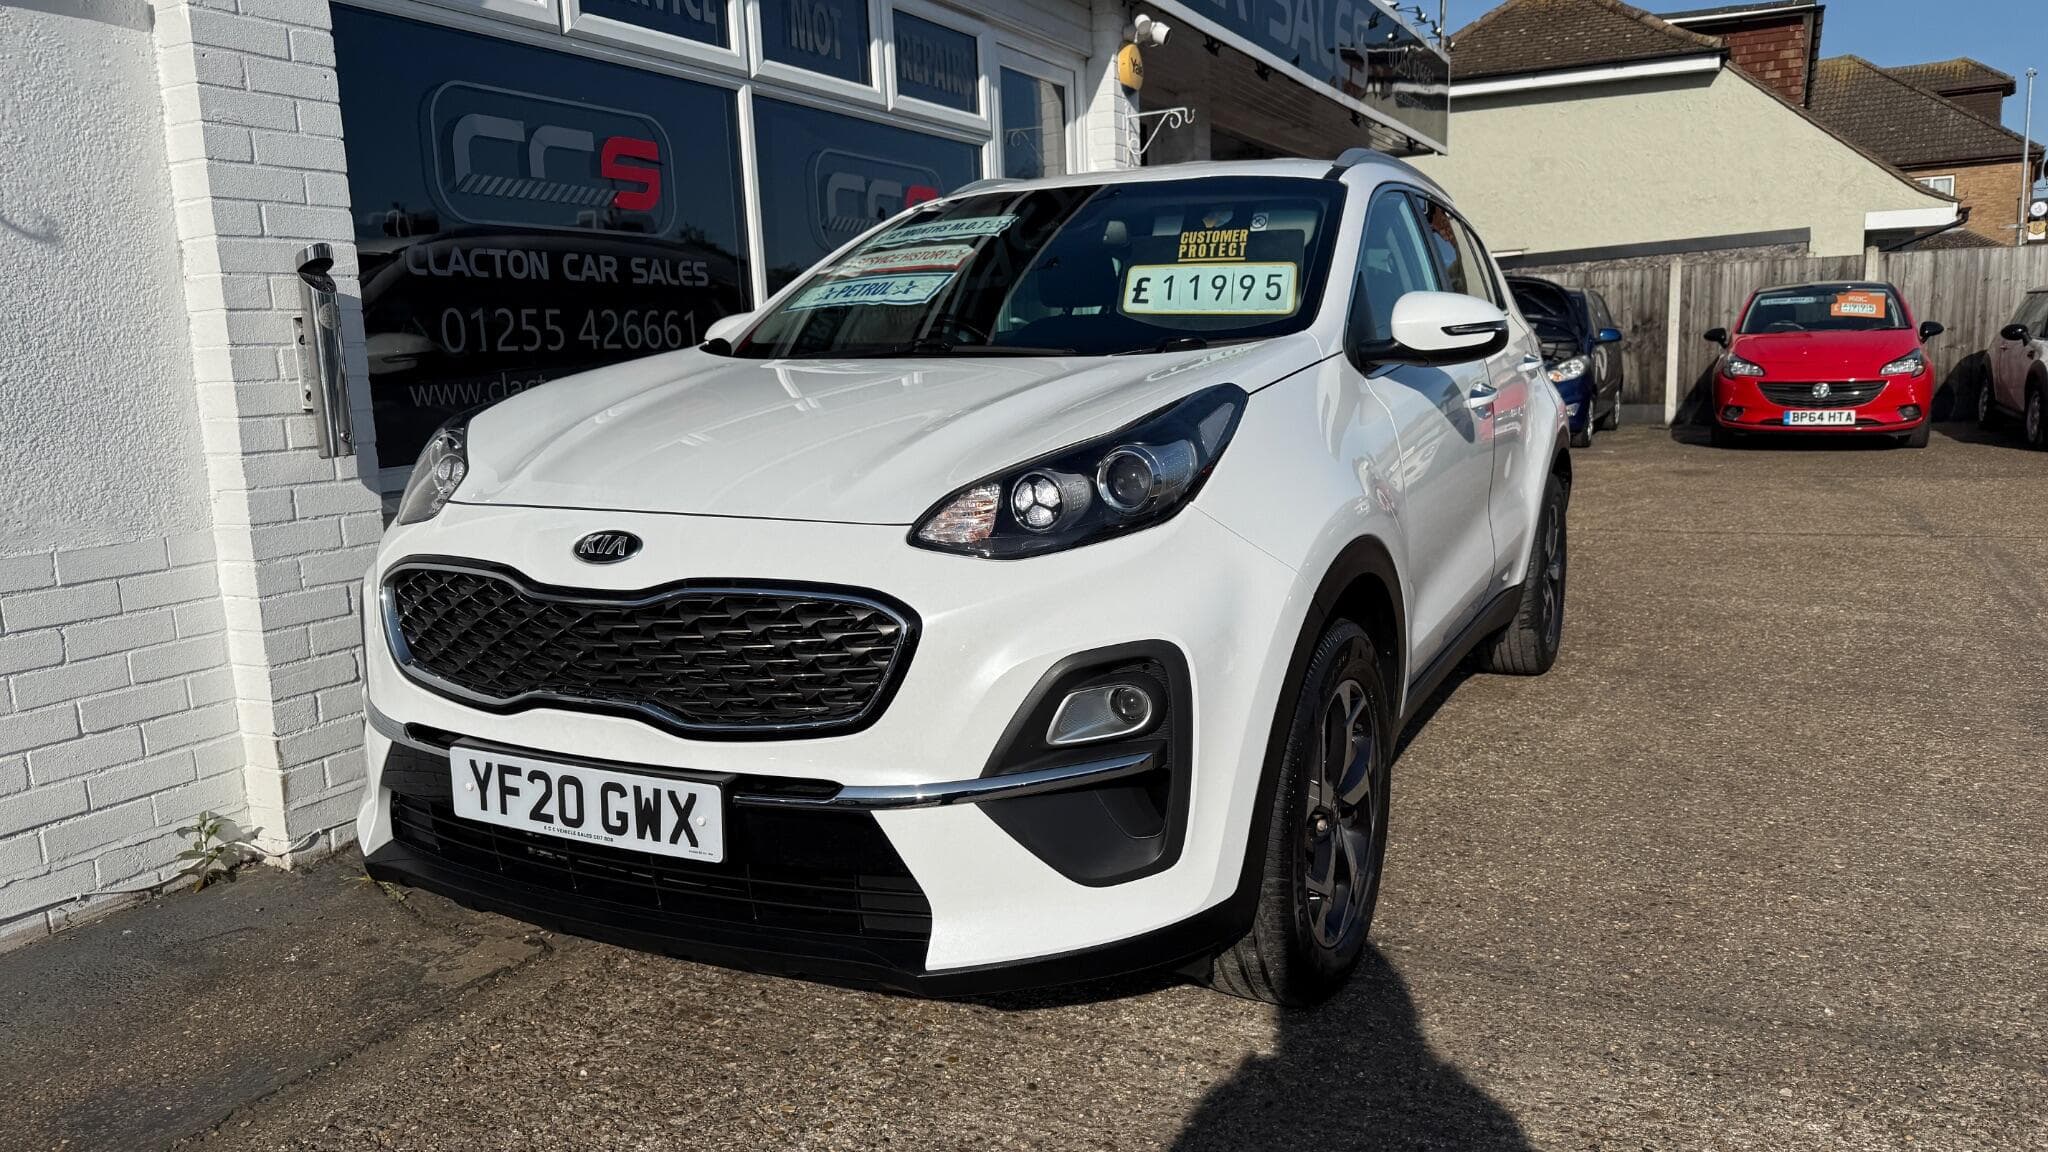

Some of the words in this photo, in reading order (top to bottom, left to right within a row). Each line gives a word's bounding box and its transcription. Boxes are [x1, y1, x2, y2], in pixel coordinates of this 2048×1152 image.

[790, 0, 842, 60] MOT
[901, 35, 973, 95] REPAIRS
[1178, 243, 1247, 258] PROTECT
[1180, 229, 1249, 244] CUSTOMER
[405, 245, 549, 281] CLACTON
[563, 252, 618, 283] CAR
[631, 257, 709, 287] SALES
[837, 281, 895, 299] PETROL
[441, 307, 565, 353] 01255
[578, 308, 698, 351] 426661
[1792, 412, 1824, 422] BP64
[1828, 412, 1853, 422] HTA
[580, 534, 628, 556] KIA
[469, 758, 586, 829] YF20
[600, 781, 699, 848] GWX
